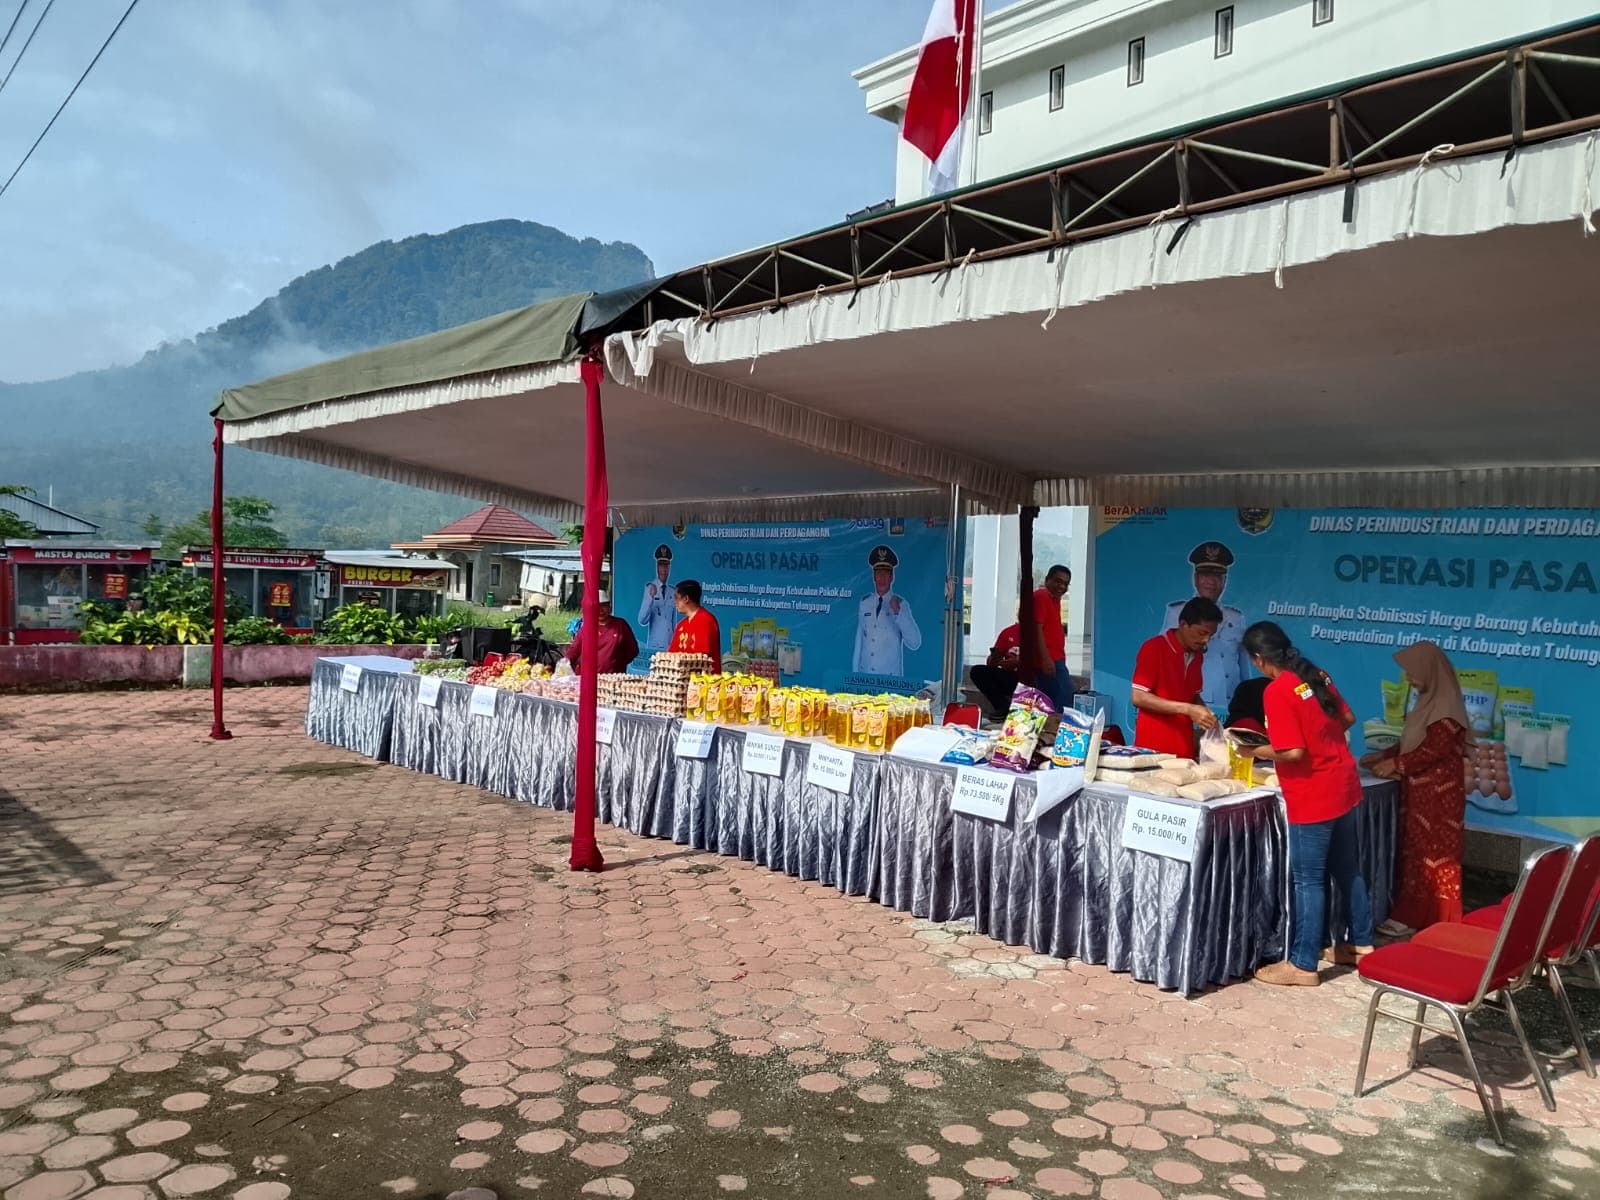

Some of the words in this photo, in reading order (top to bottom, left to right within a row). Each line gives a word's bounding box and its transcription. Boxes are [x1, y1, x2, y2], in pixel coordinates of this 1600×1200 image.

[780, 527, 830, 538] PERDAGANGAN
[1309, 516, 1354, 532] DINAS
[1356, 516, 1480, 535] PERINDUSTRIAN
[1484, 518, 1521, 535] DAN
[35, 551, 74, 559] MASTER
[75, 551, 111, 560] BURGER
[200, 553, 231, 562] KEB
[711, 551, 766, 570] OPERASI
[769, 552, 820, 572] PASAR
[344, 566, 414, 583] BURGER
[1334, 554, 1476, 589] OPERASI
[1268, 601, 1306, 615] Dalam
[1309, 602, 1355, 621] Rangka
[1356, 605, 1427, 625] Stabilisasi
[1429, 610, 1471, 631] Harga
[1474, 613, 1529, 636] Barang
[1531, 616, 1600, 636] Kebutuh
[1310, 624, 1394, 645] Pengendalian
[1443, 635, 1458, 650] di
[1460, 636, 1541, 659] Kabupaten
[1463, 694, 1488, 705] PHP
[962, 774, 985, 787] BERAS
[985, 780, 1009, 791] LAHAP
[1137, 808, 1160, 822] GULA
[1161, 813, 1188, 828] PASIR
[1131, 822, 1145, 836] Rp.
[1147, 826, 1175, 840] 15.000/
[1175, 831, 1188, 846] Kg
